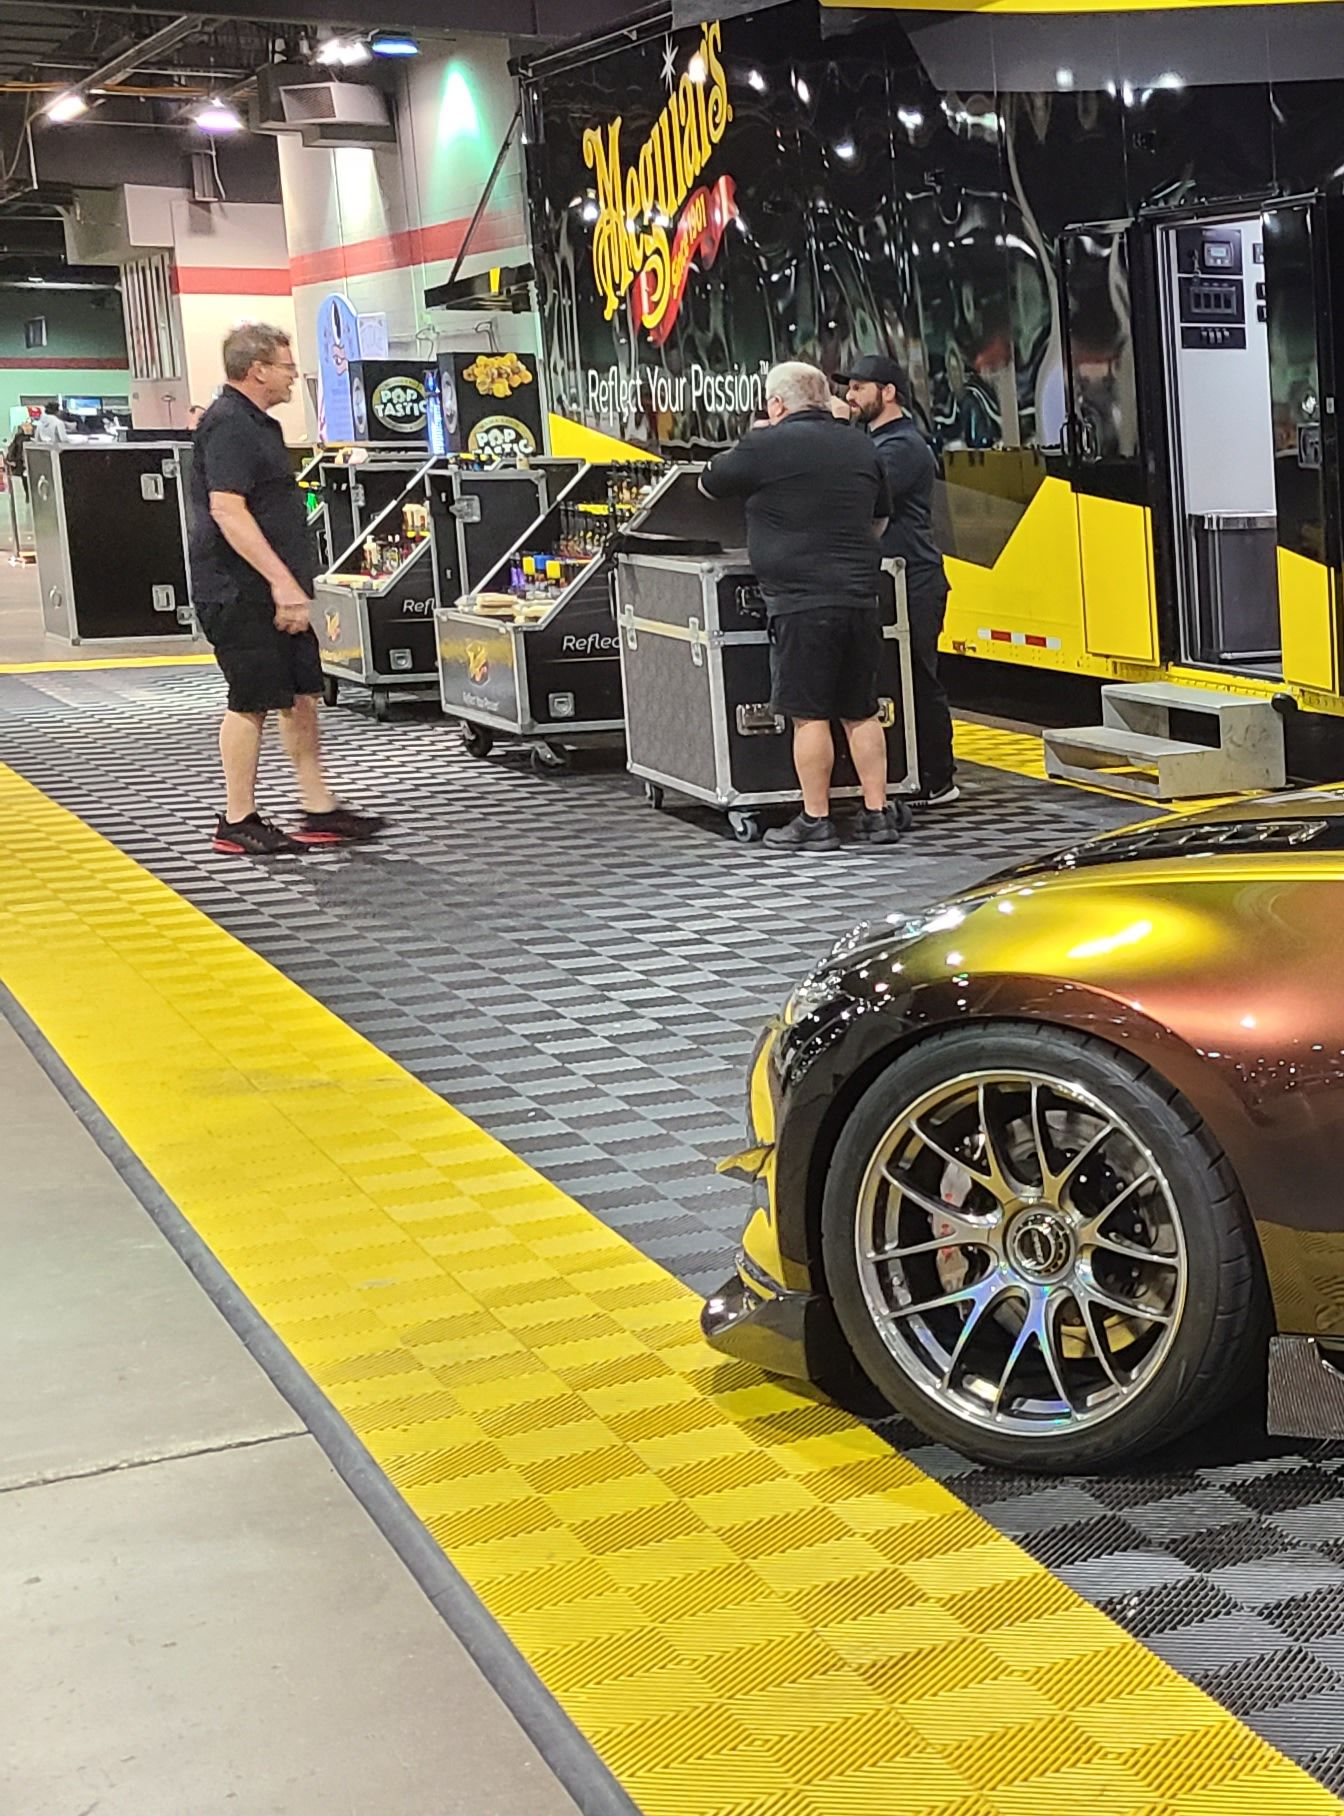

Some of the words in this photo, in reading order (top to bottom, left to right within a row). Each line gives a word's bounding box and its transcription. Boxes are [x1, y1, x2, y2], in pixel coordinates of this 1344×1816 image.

[381, 387, 418, 404] POP
[588, 365, 645, 427] Reflect
[646, 365, 688, 413] Your
[476, 428, 516, 447] POP
